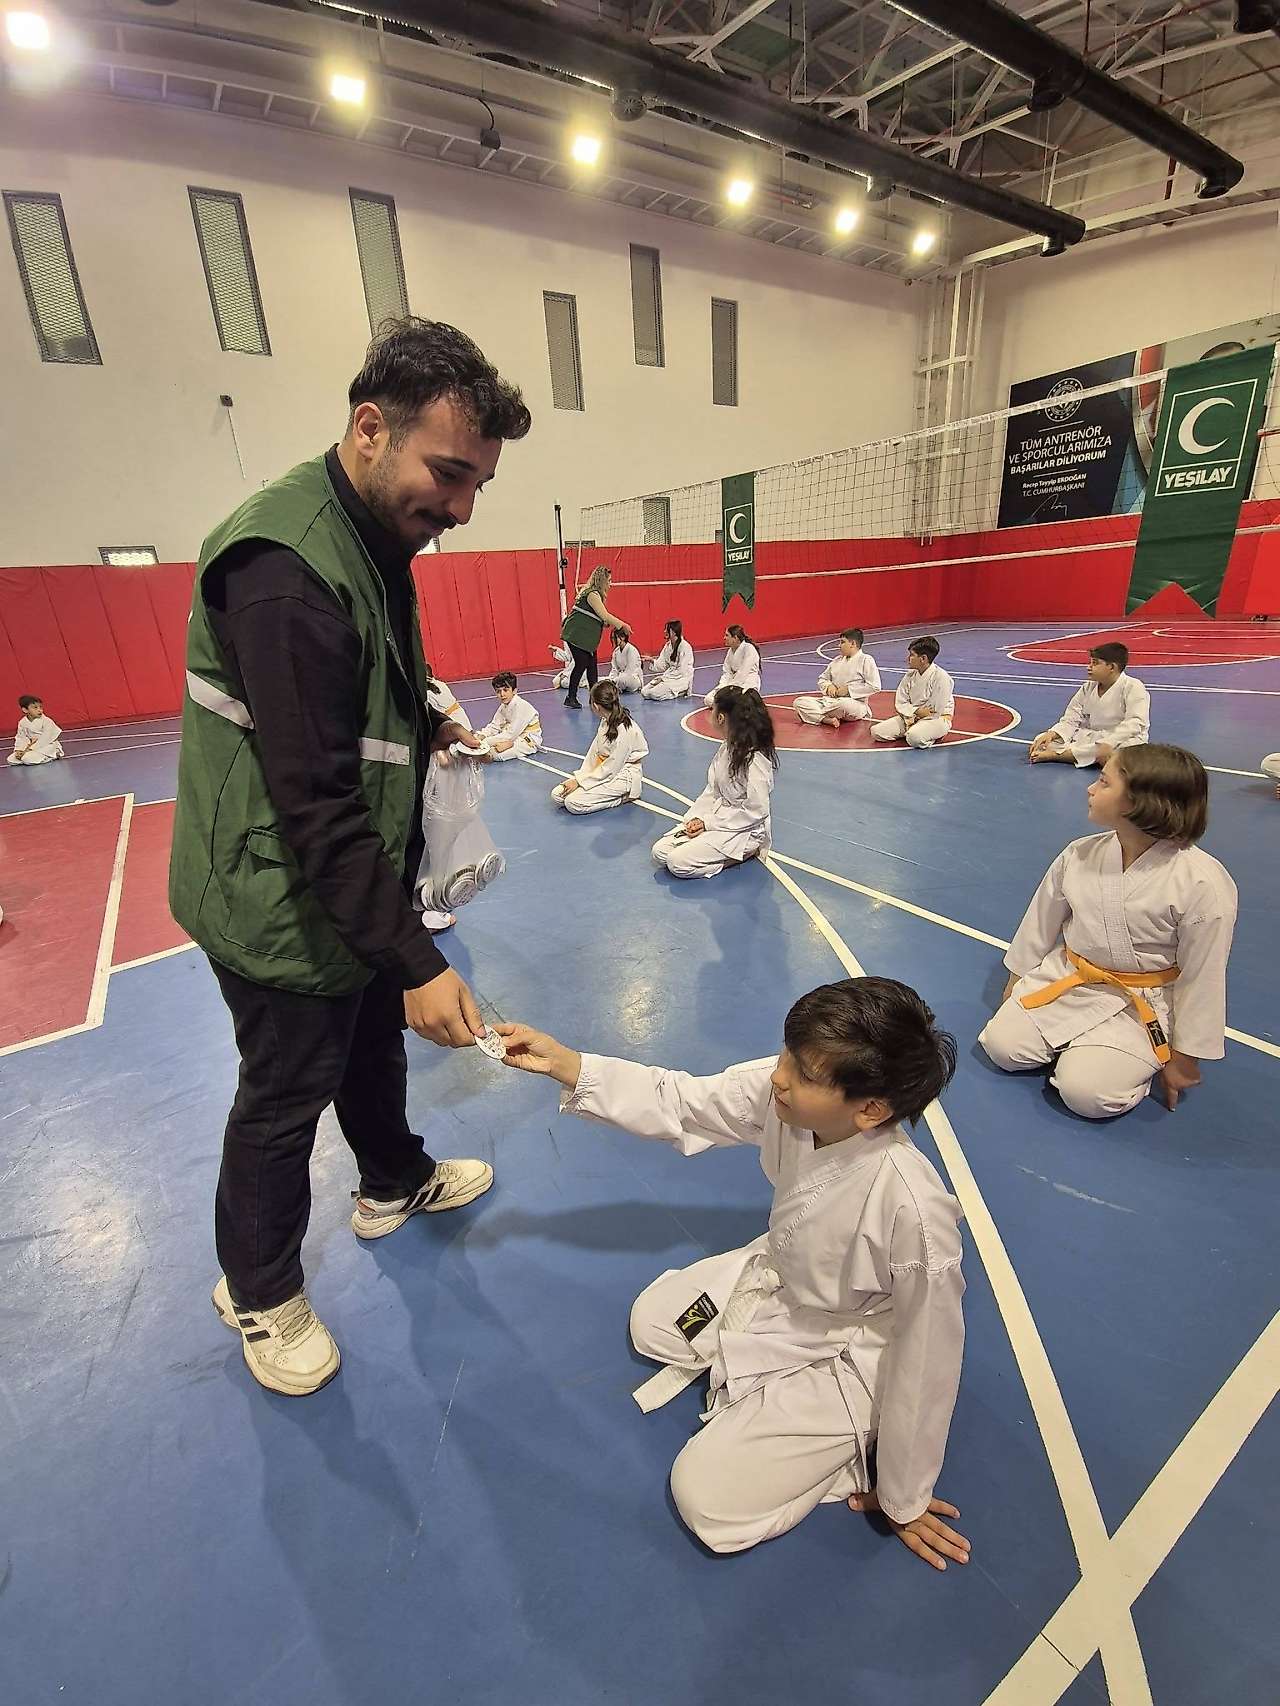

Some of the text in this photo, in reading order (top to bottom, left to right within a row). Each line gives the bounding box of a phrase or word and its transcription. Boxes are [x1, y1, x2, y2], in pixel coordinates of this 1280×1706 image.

[1008, 435, 1112, 464] VE SPORCULARIMIZA
[1020, 425, 1102, 451] TÜM ANTRENÖR
[1010, 449, 1107, 475] BAŞARILAR DİLİYORUM
[1022, 481, 1039, 489] Recep
[1057, 473, 1087, 484] ERDOĞAN
[1032, 482, 1086, 496] CUMHURBAŞKANI
[1164, 466, 1233, 489] YEŞİLAY
